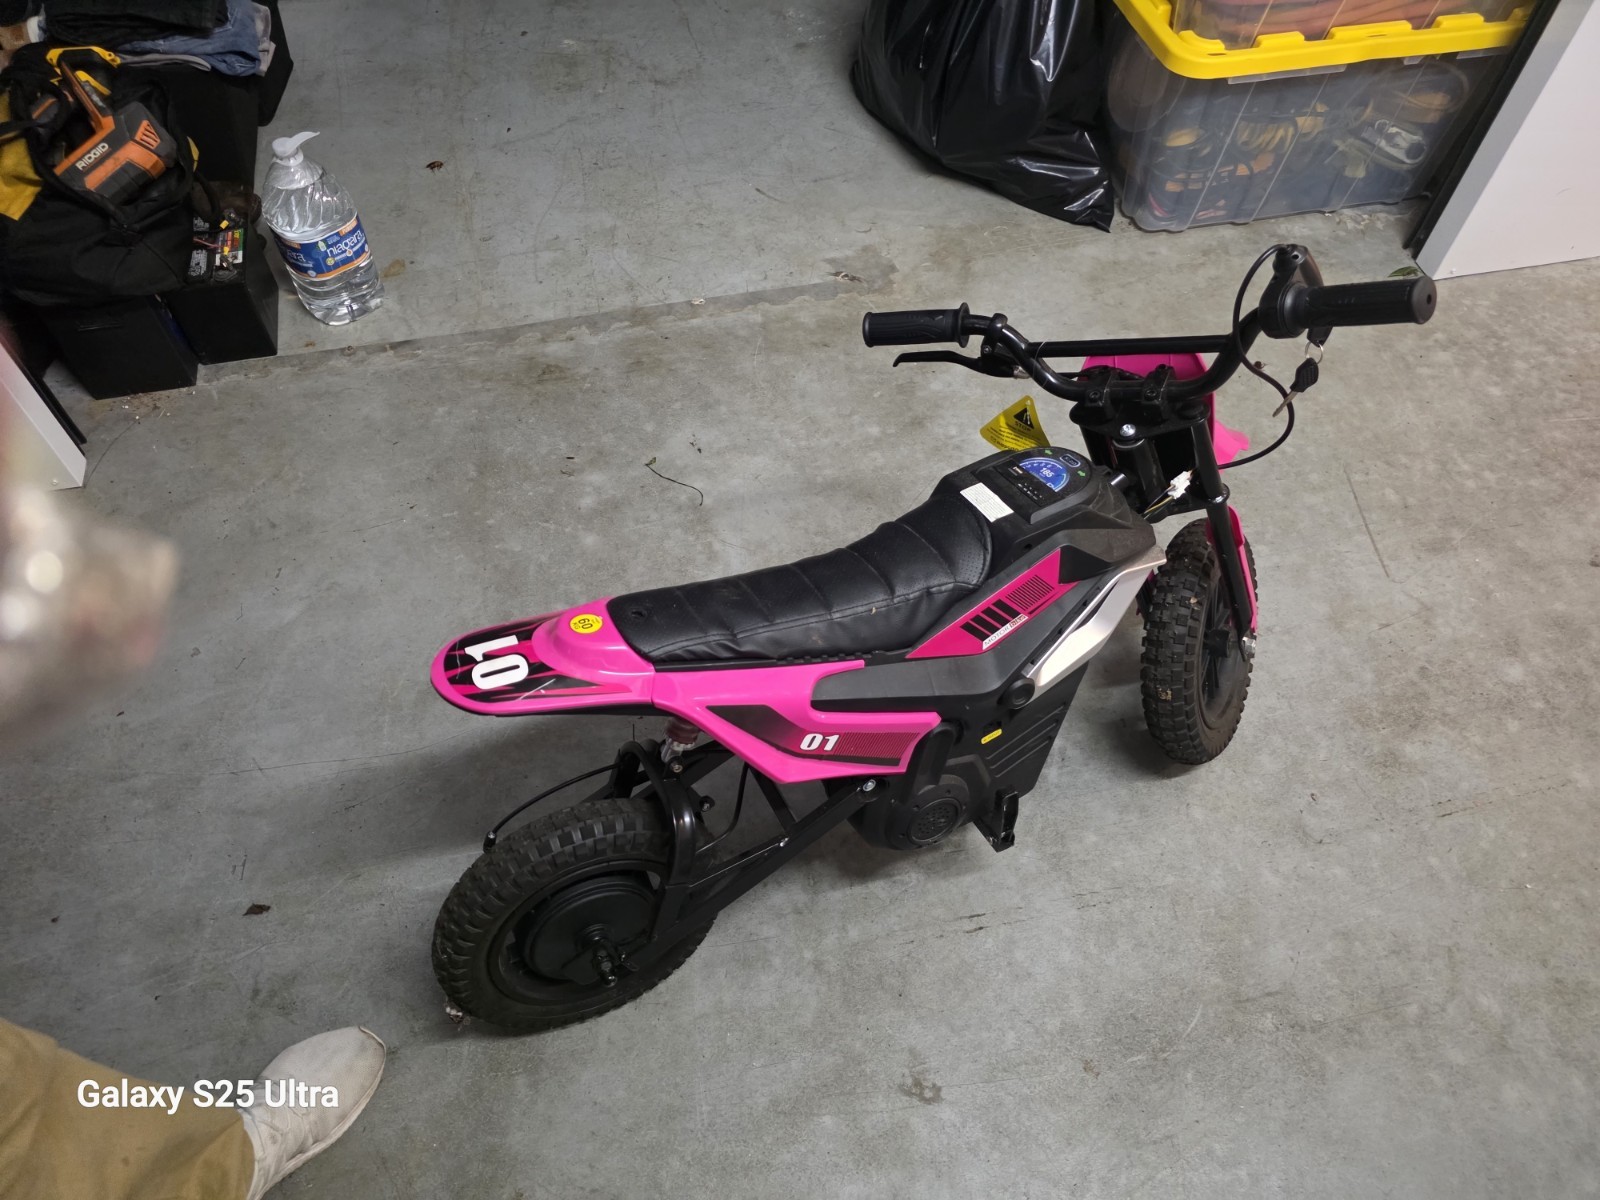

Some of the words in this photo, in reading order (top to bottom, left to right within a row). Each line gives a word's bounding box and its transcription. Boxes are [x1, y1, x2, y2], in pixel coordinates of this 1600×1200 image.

[75, 142, 109, 171] RIDGID
[326, 230, 363, 257] niagara
[1039, 467, 1055, 478] 185
[578, 617, 593, 630] 60
[464, 634, 529, 690] 01
[799, 733, 840, 751] 01
